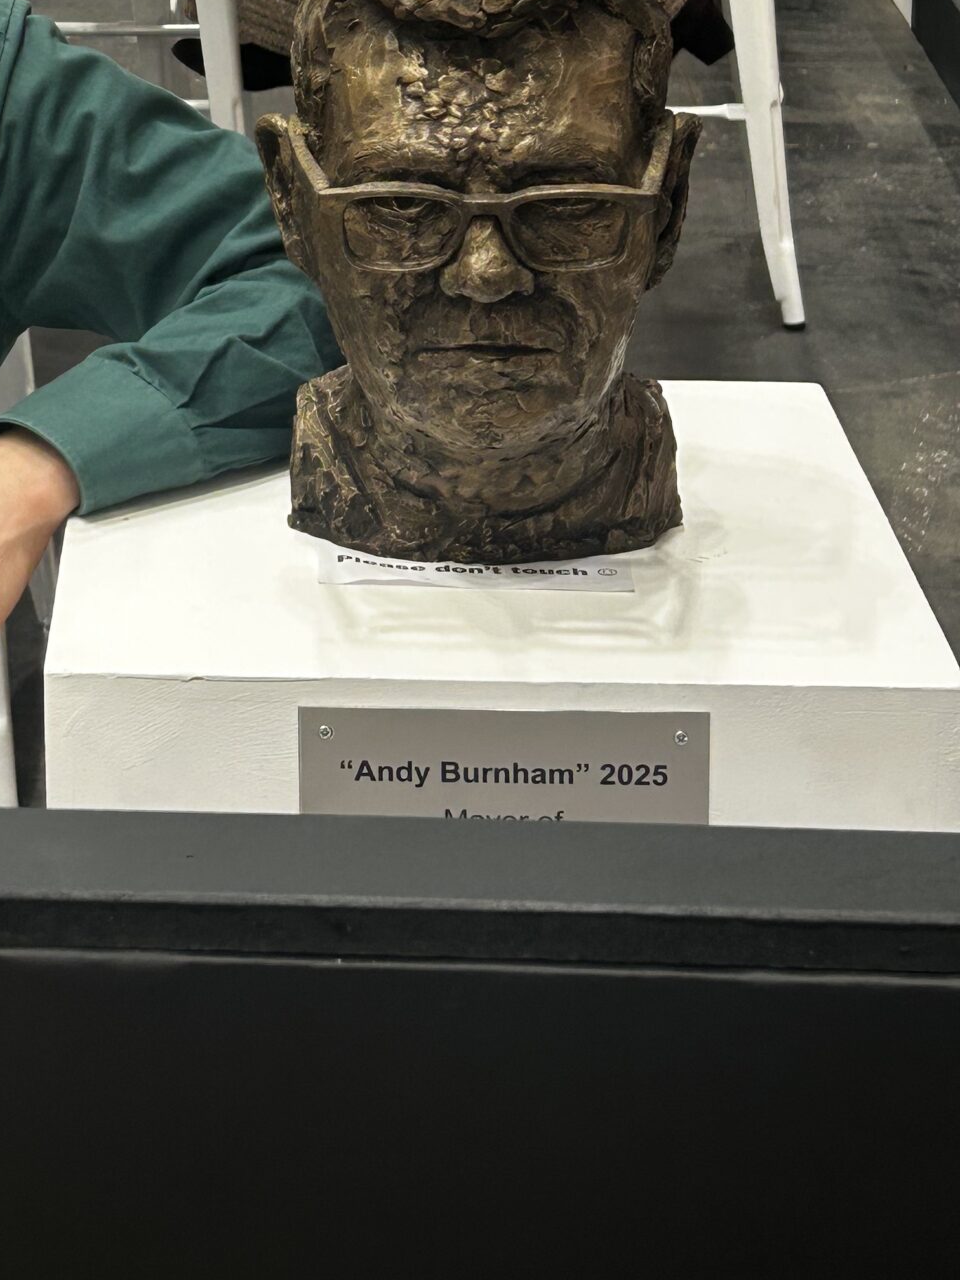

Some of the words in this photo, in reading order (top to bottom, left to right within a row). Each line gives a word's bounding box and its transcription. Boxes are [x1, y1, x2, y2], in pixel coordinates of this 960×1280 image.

[337, 555, 425, 571] Please
[511, 567, 588, 576] touch
[340, 760, 430, 788] “Andy
[441, 760, 590, 785] Burnham”
[599, 763, 668, 786] 2025
